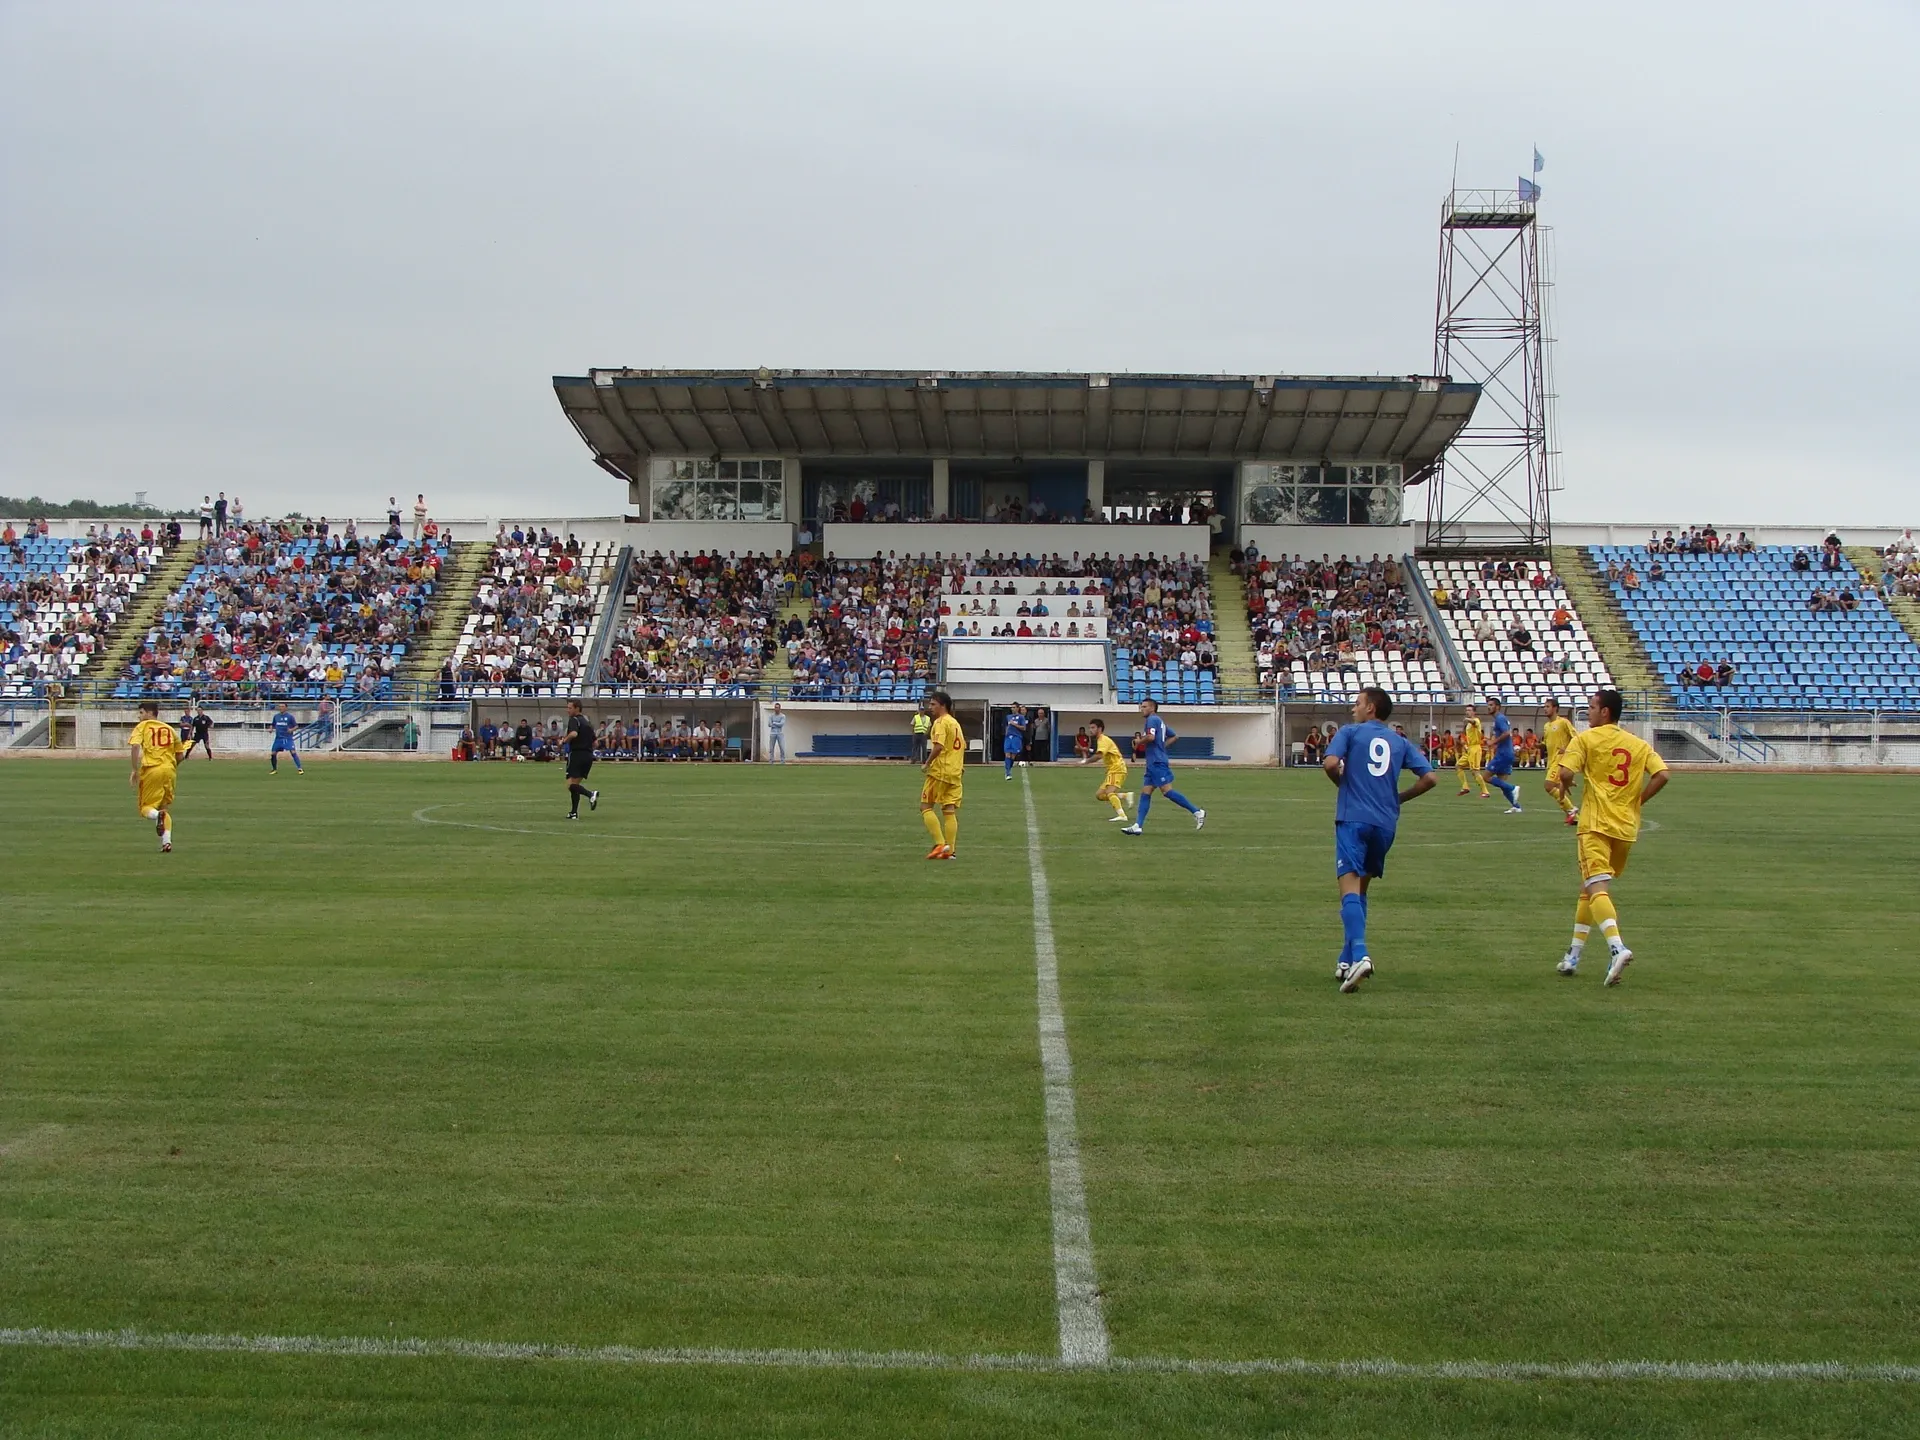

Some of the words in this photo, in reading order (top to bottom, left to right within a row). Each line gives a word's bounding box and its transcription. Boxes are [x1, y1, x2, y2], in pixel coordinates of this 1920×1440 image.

[149, 727, 172, 747] 10
[953, 728, 961, 750] 6
[1367, 737, 1391, 777] 9
[1608, 748, 1632, 787] 3
